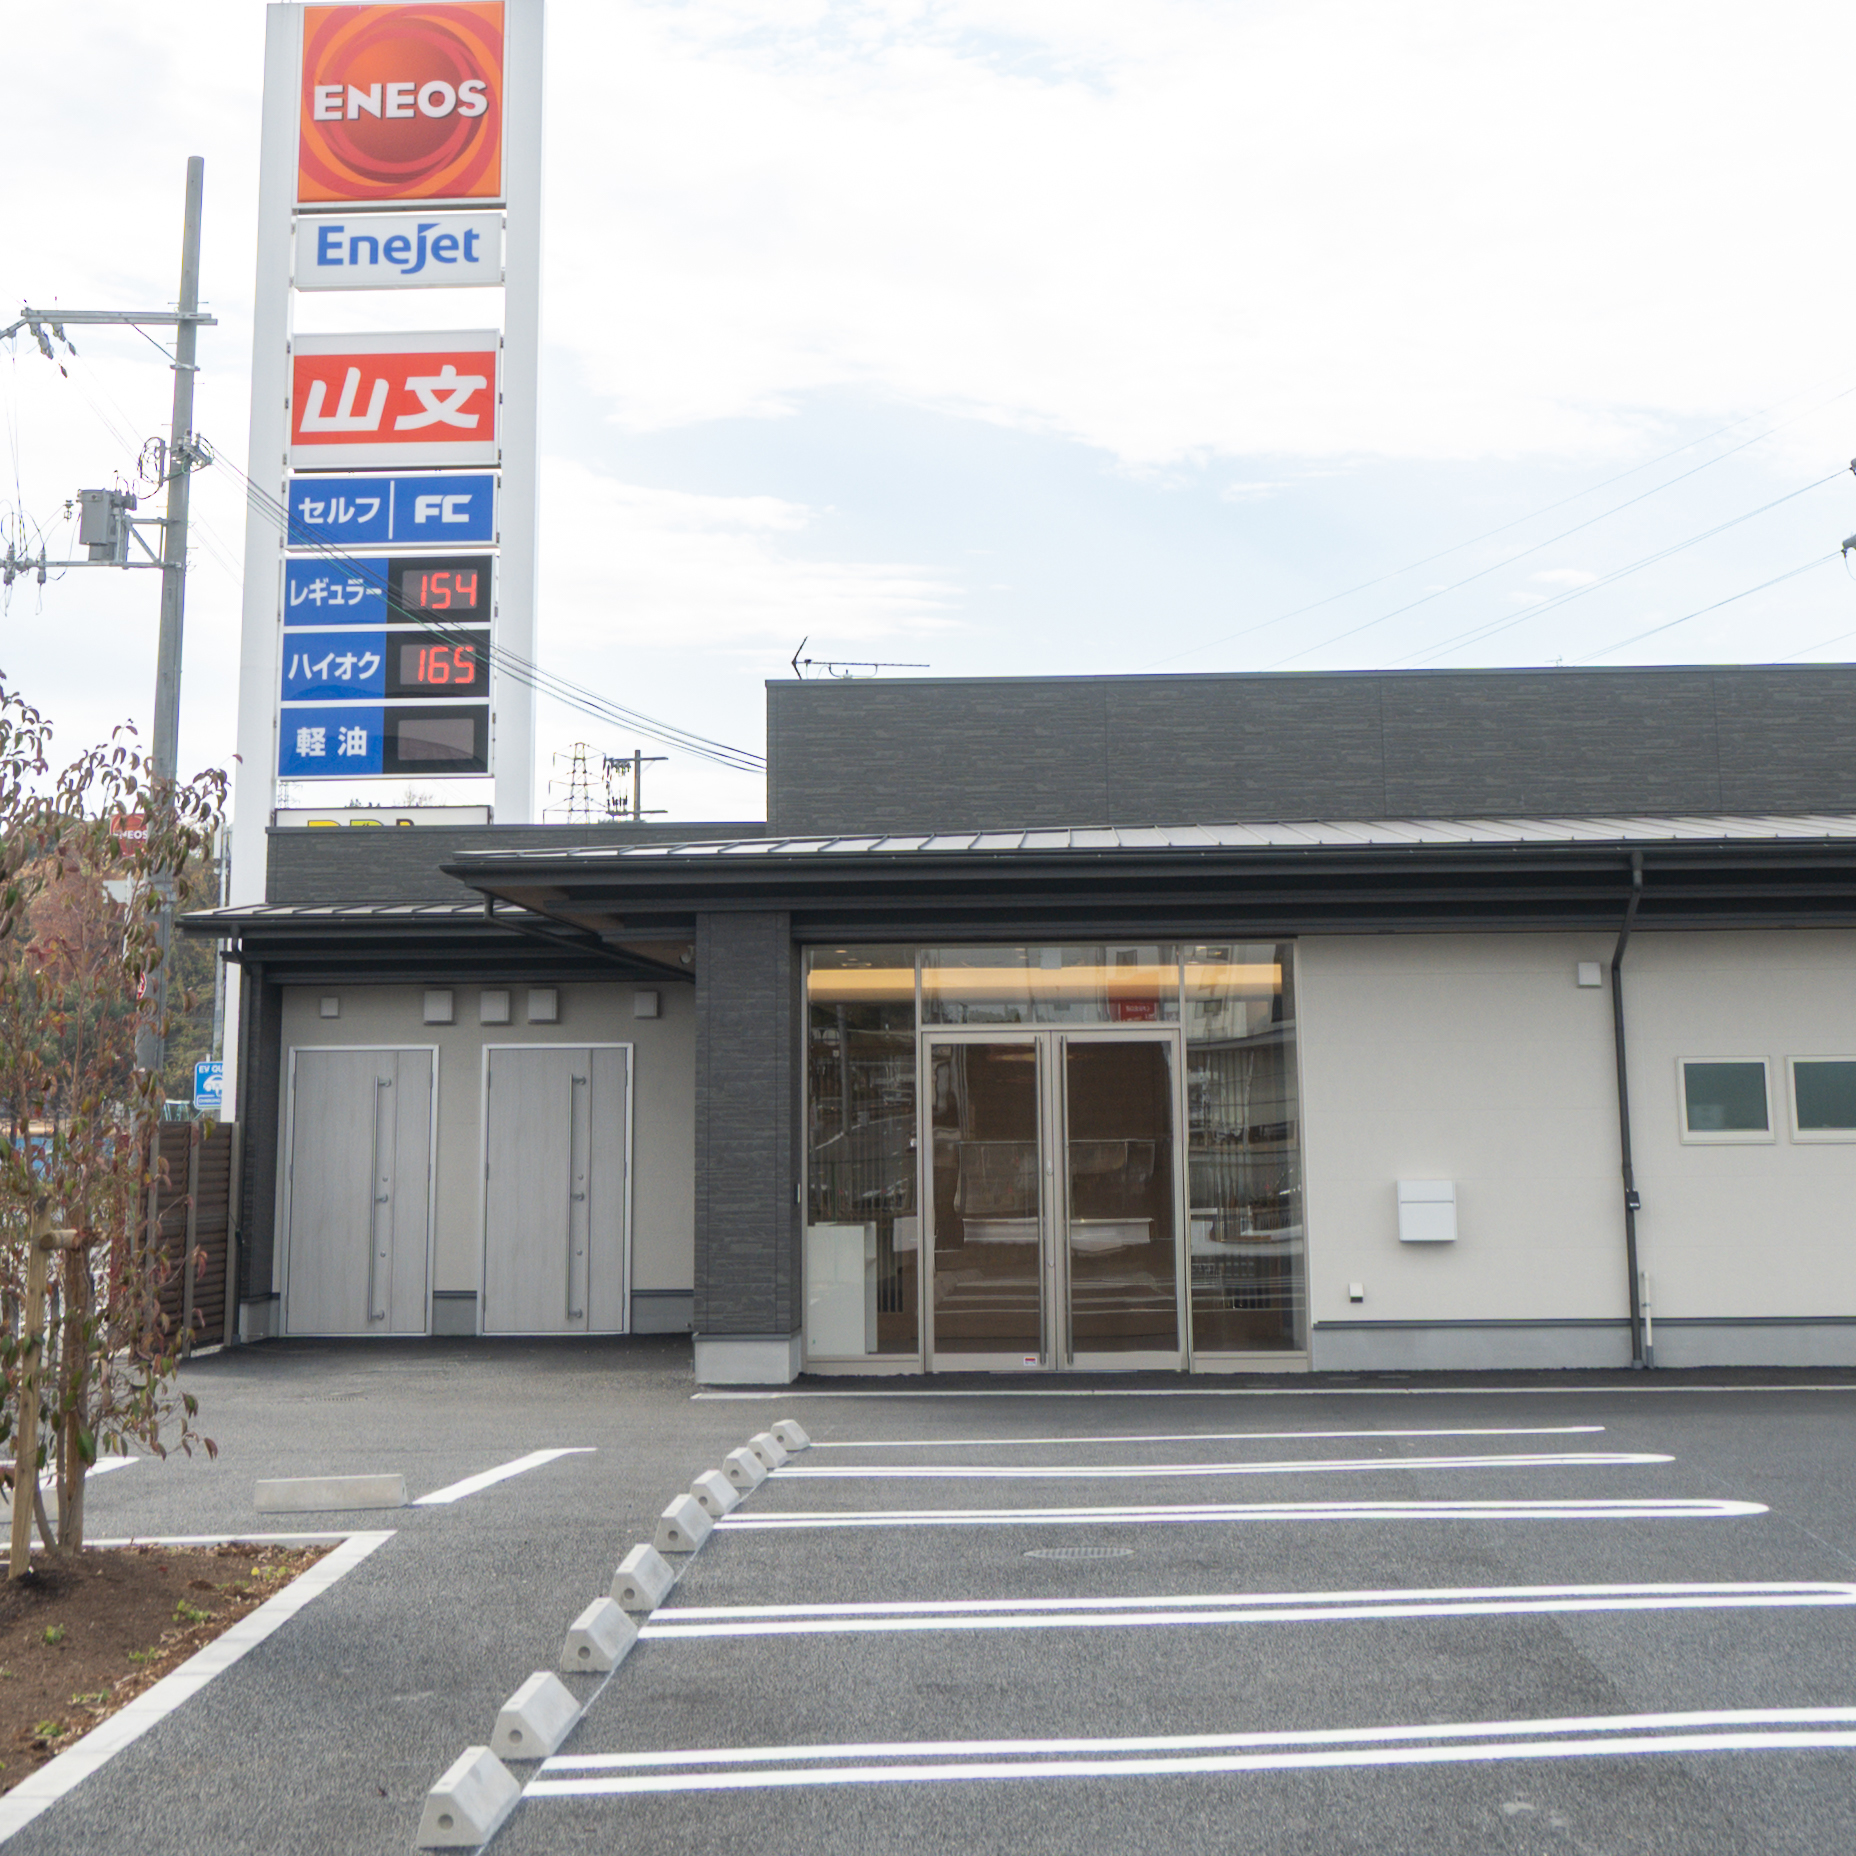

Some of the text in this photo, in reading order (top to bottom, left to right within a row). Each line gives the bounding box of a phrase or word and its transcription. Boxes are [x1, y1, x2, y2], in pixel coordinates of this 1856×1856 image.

[313, 79, 488, 121] ENEOS
[316, 222, 480, 275] Enejet
[299, 364, 488, 433] 山文
[298, 494, 473, 524] セルフ FC
[290, 571, 478, 610] レギュラー 154
[288, 645, 475, 684] ハイオク 165
[296, 726, 367, 757] 軽油
